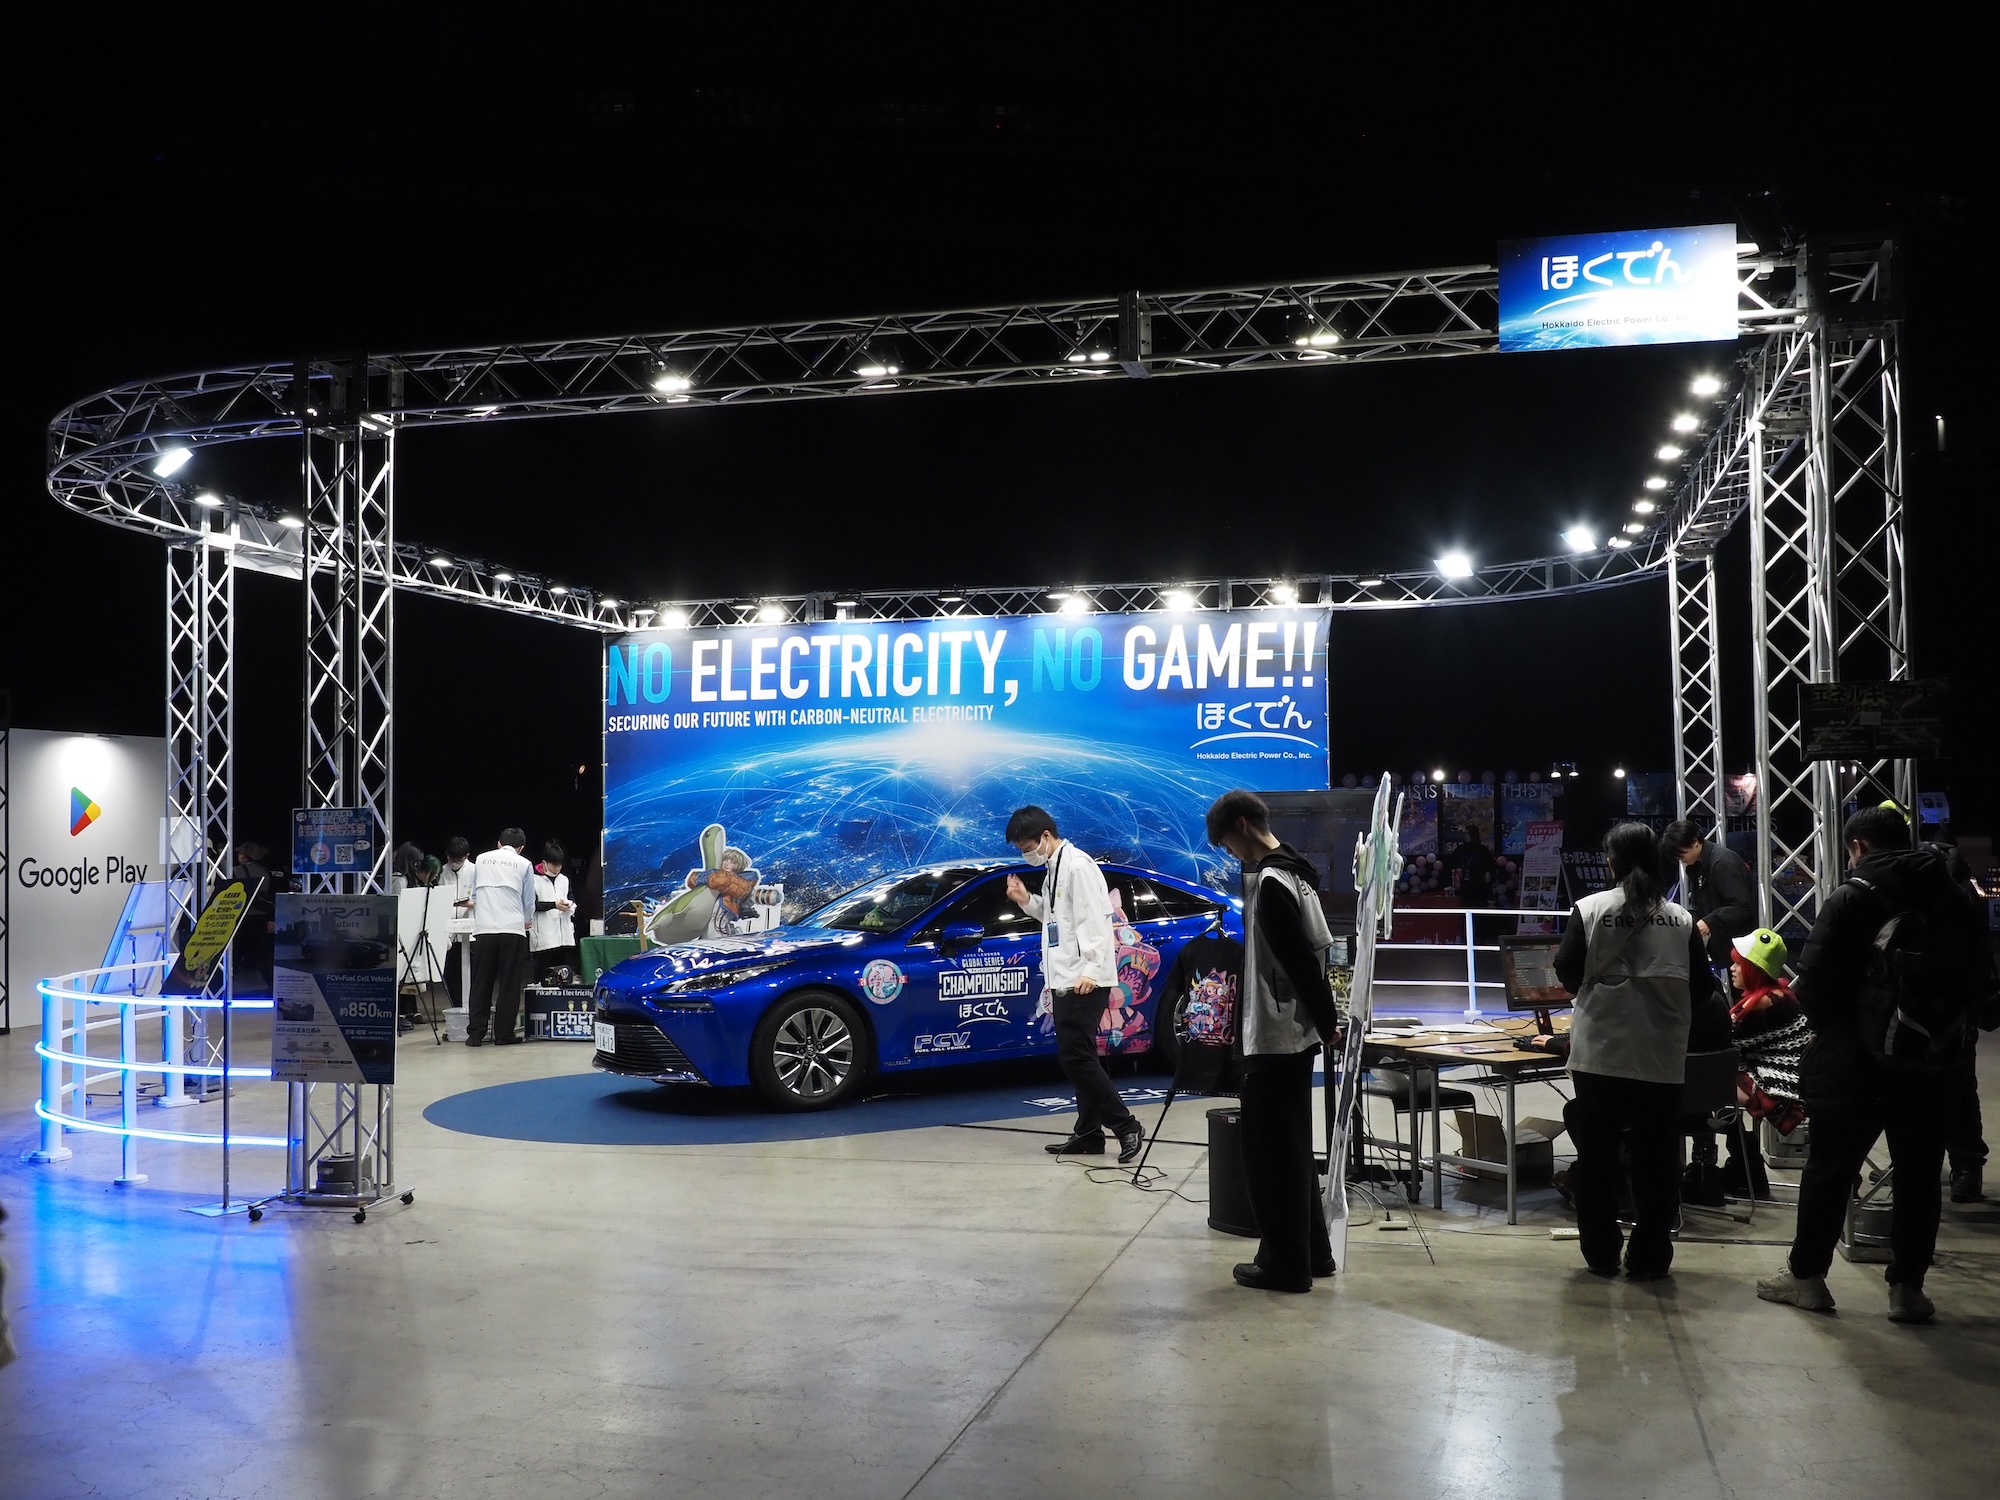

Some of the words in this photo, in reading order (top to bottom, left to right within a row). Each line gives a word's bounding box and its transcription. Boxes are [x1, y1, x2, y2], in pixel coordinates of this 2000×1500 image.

[1541, 240, 1693, 290] ほくでん
[1542, 318, 1585, 330] Hokkaido
[1587, 316, 1621, 327] Electric
[1624, 314, 1652, 325] Power
[608, 642, 672, 706] NO
[690, 629, 1020, 707] ELECTRICITY,
[1033, 626, 1102, 692] NO
[1123, 621, 1316, 692] GAME!!
[608, 713, 669, 731] SECURING
[672, 712, 700, 730] OUR
[703, 711, 750, 729] FUTURE
[754, 710, 787, 728] WITH
[790, 706, 909, 727] CARBON-NEUTRAL
[912, 704, 994, 723] ELECTRICITY
[1196, 694, 1312, 731] ほくでん
[1196, 751, 1229, 761] Hokkaido
[1231, 751, 1257, 761] Electric
[1259, 751, 1281, 761] Power
[1283, 751, 1297, 762] Co.,
[1299, 751, 1312, 760] Inc.
[1423, 783, 1438, 799] IS
[1501, 783, 1537, 799] THIS
[19, 857, 100, 894] Google
[107, 856, 148, 885] Play
[301, 907, 370, 919] MIRAI
[961, 958, 983, 968] GLOBAL
[984, 956, 1005, 967] SERIES
[326, 974, 356, 982] FCV=Fuel
[357, 974, 369, 982] Cell
[371, 975, 393, 983] Vehicle
[942, 971, 1025, 996] CHAMPIONSHIP
[535, 989, 562, 997] PikaPika
[563, 989, 594, 998] Electricity
[339, 1001, 393, 1018] 約850km
[959, 998, 1009, 1019] ほくでん
[914, 1031, 971, 1050] FCV
